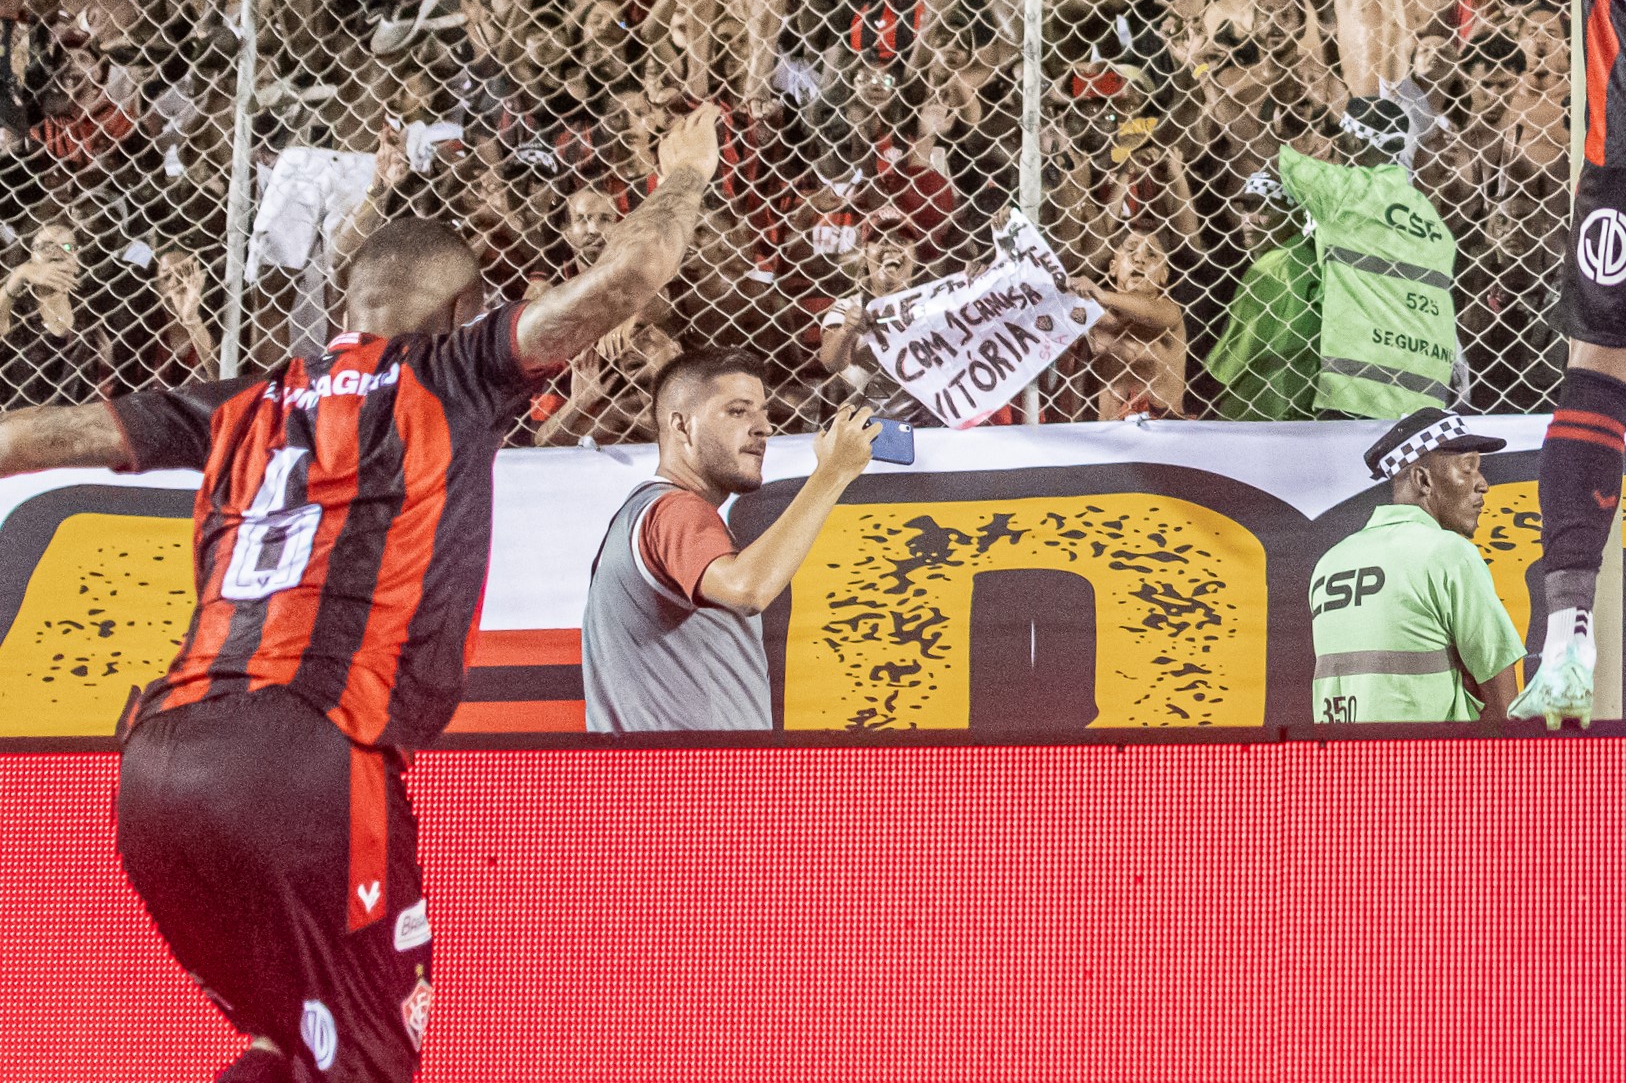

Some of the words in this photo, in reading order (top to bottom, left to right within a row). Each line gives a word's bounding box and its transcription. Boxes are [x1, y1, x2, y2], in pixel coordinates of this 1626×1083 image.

[896, 331, 958, 382] COM
[932, 321, 1041, 420] VITÓRIA
[1311, 565, 1386, 617] CSP
